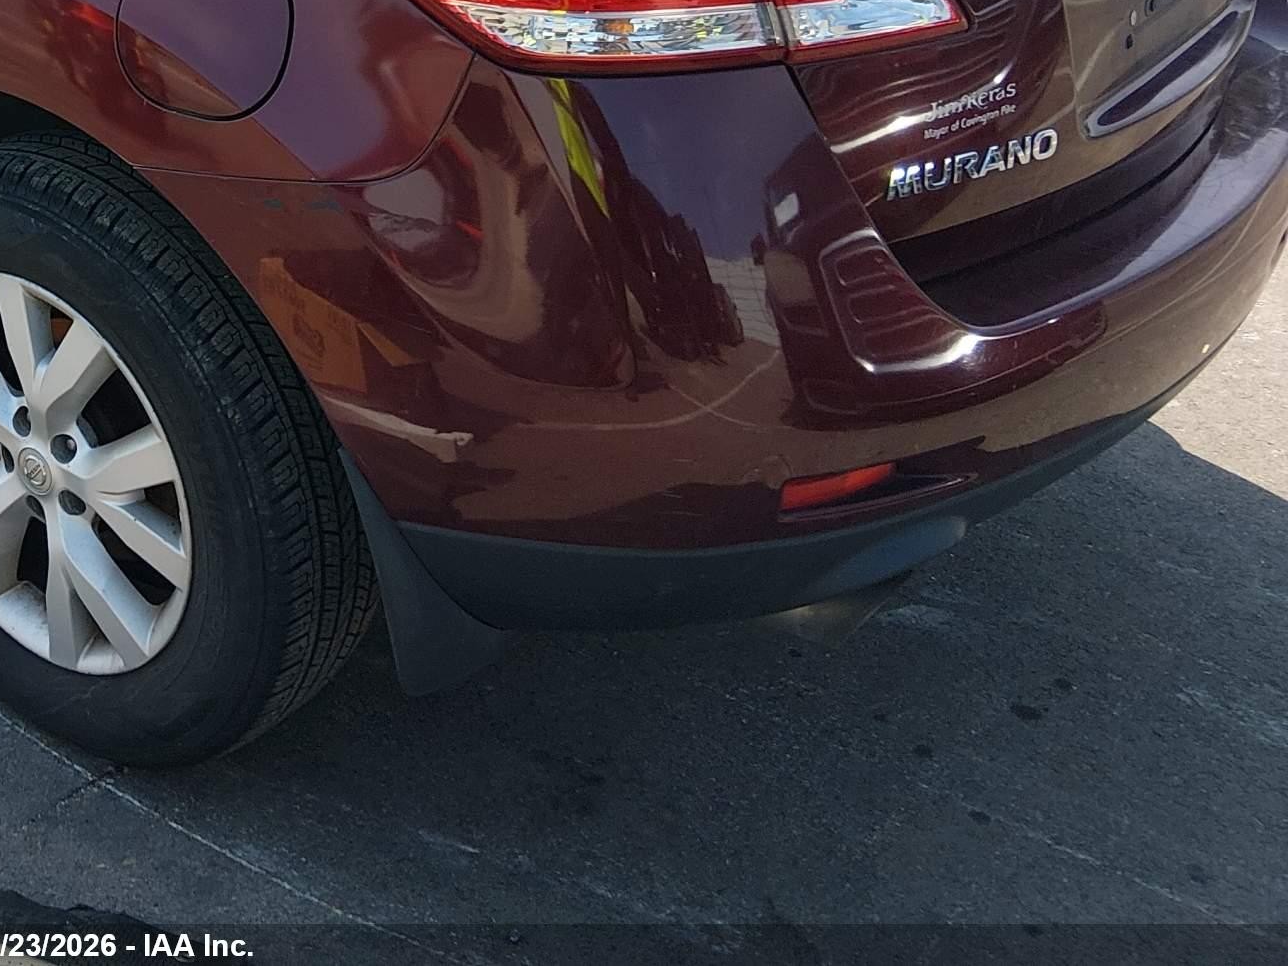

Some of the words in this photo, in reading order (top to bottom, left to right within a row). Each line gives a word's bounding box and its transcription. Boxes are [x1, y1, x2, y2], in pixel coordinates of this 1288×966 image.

[923, 126, 949, 140] Mayor
[951, 120, 960, 131] of
[960, 110, 1000, 128] Covington
[886, 128, 1059, 202] MURANO
